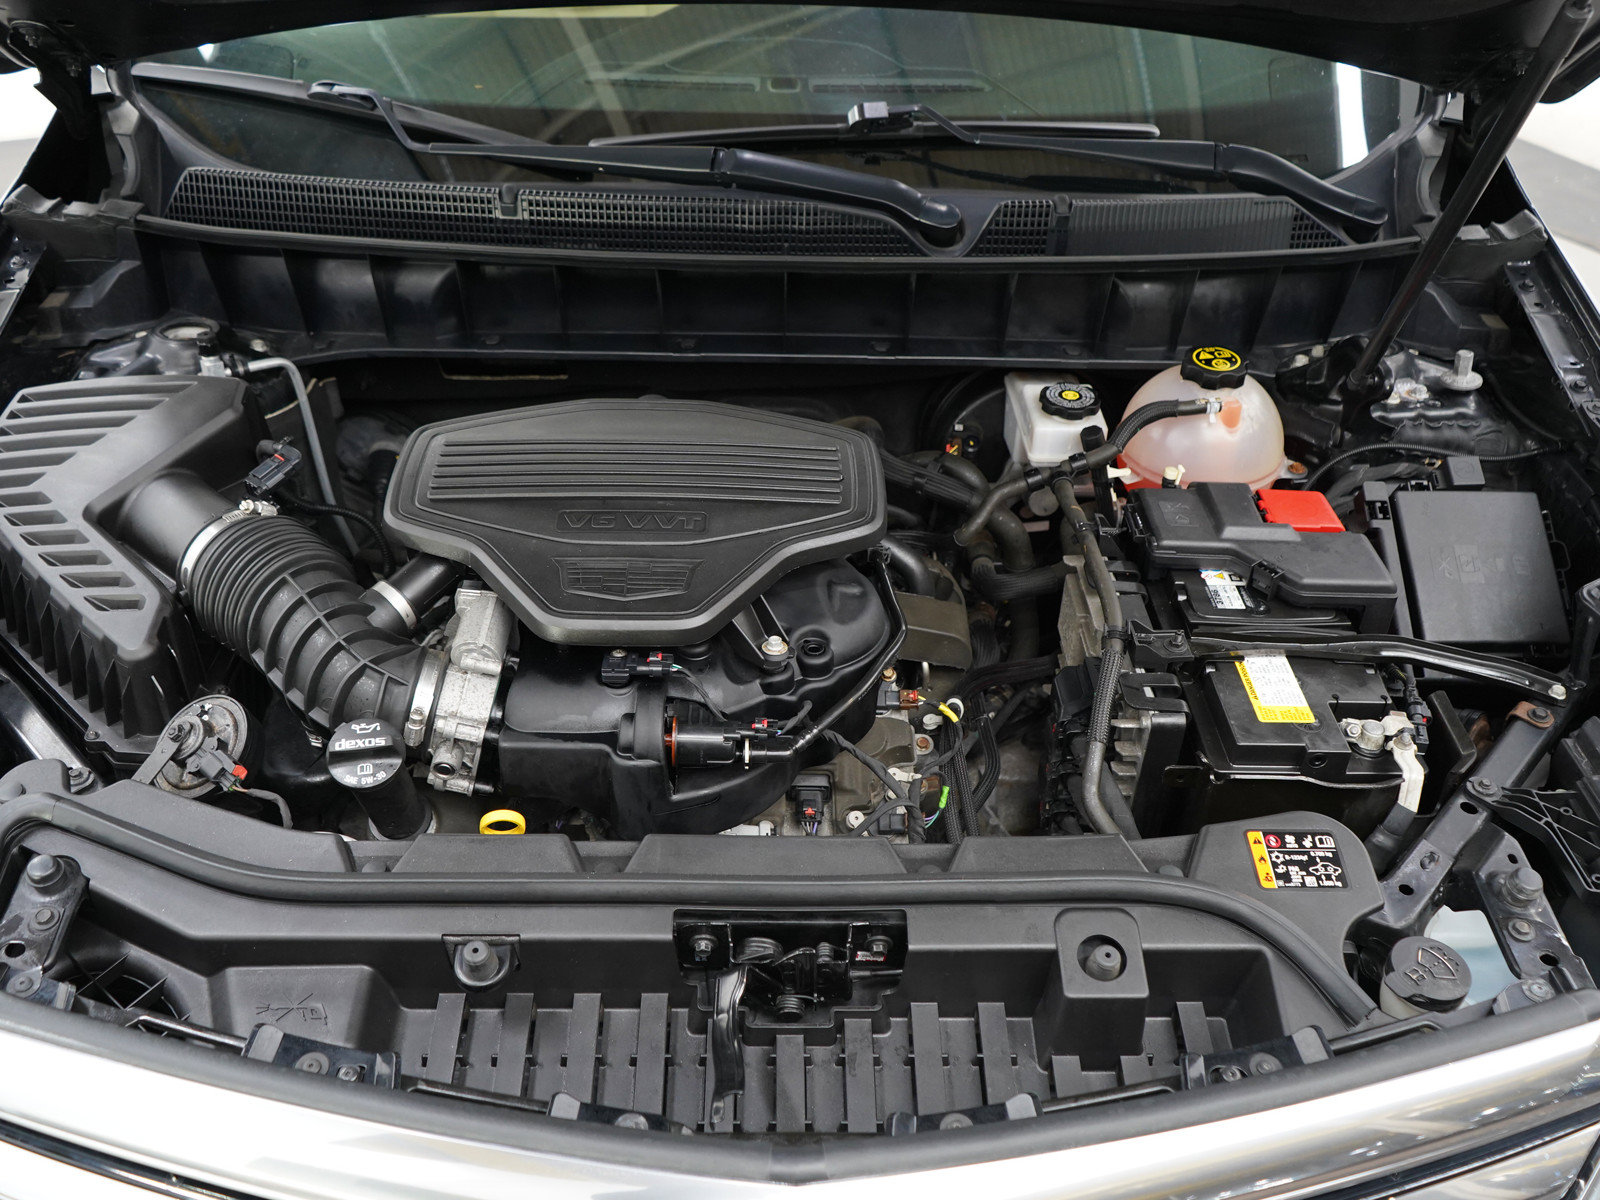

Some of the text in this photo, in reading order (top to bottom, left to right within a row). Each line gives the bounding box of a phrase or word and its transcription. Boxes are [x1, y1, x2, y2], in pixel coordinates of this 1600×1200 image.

[564, 514, 702, 529] V6 VVT
[334, 737, 387, 750] dexos
[343, 770, 387, 785] SAE 5W-30
